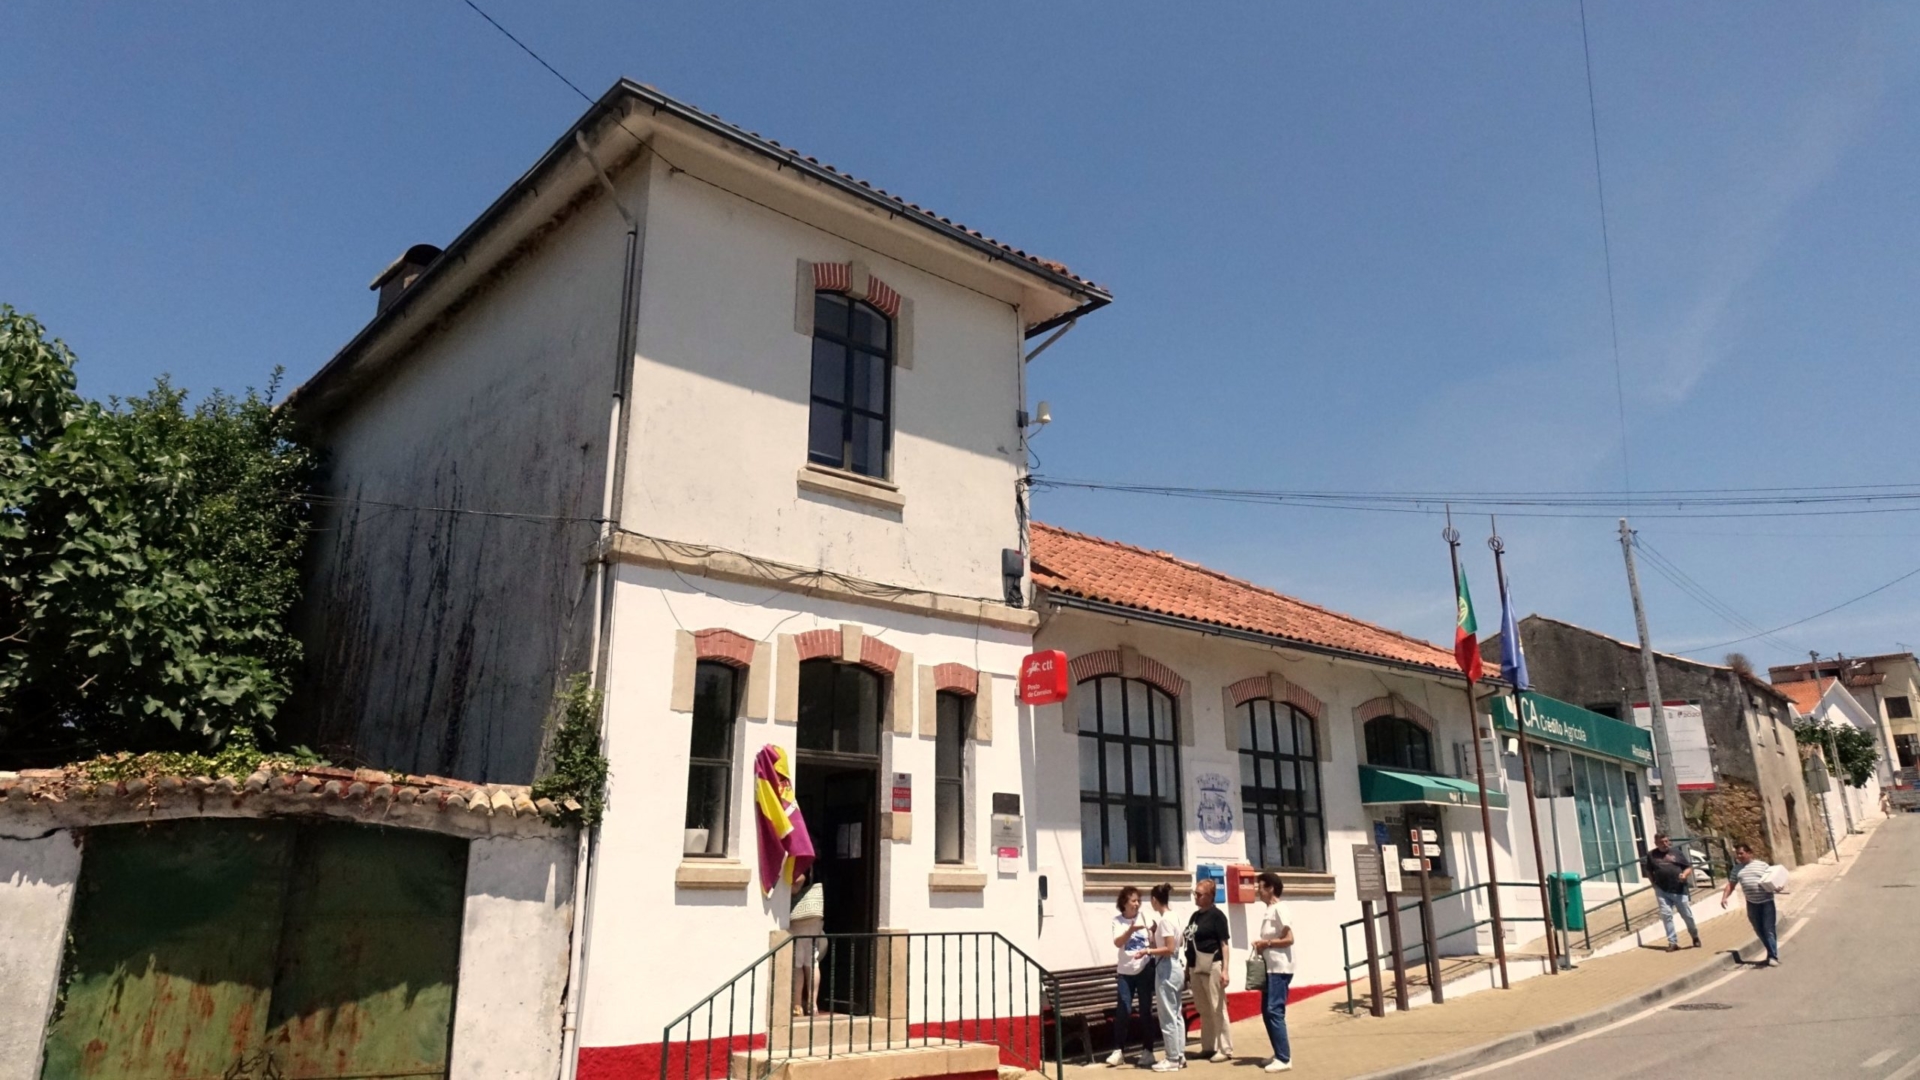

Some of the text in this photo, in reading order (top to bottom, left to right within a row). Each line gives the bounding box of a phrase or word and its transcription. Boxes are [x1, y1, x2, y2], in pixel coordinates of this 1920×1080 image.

[1041, 659, 1053, 671] ctt
[1033, 689, 1052, 697] Correios
[1520, 697, 1587, 742] CA Crédito Agrícola
